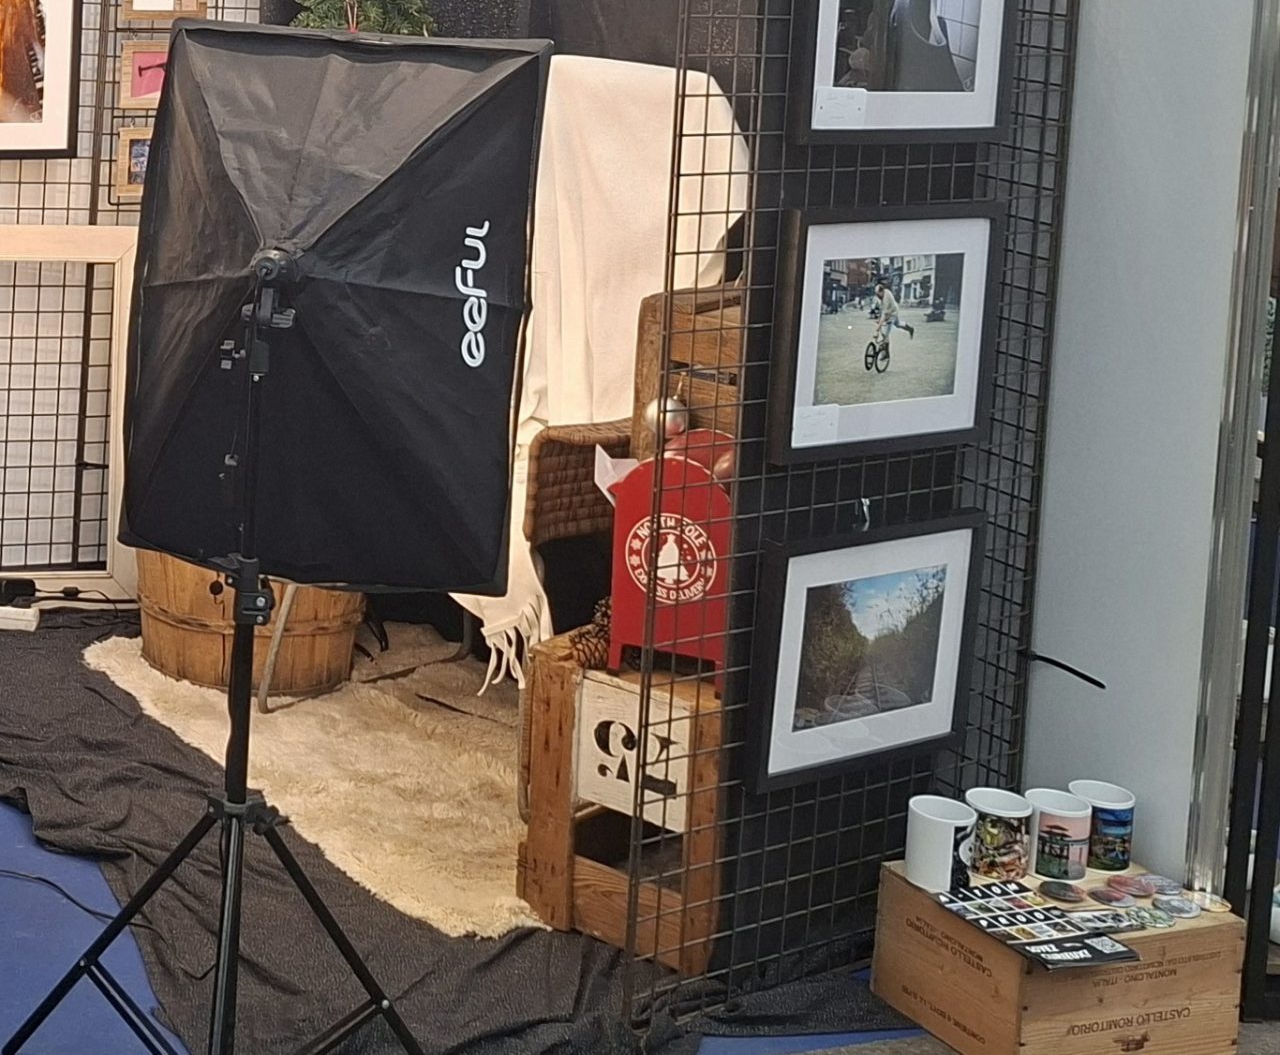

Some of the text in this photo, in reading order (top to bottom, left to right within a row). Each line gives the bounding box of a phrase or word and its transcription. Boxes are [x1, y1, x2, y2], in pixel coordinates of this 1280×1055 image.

[635, 516, 676, 540] NOTH
[951, 946, 992, 977] CASTELLO
[1123, 969, 1177, 984] MONTALCINO
[1071, 1006, 1191, 1036] CASTELLO ROMITORIO
